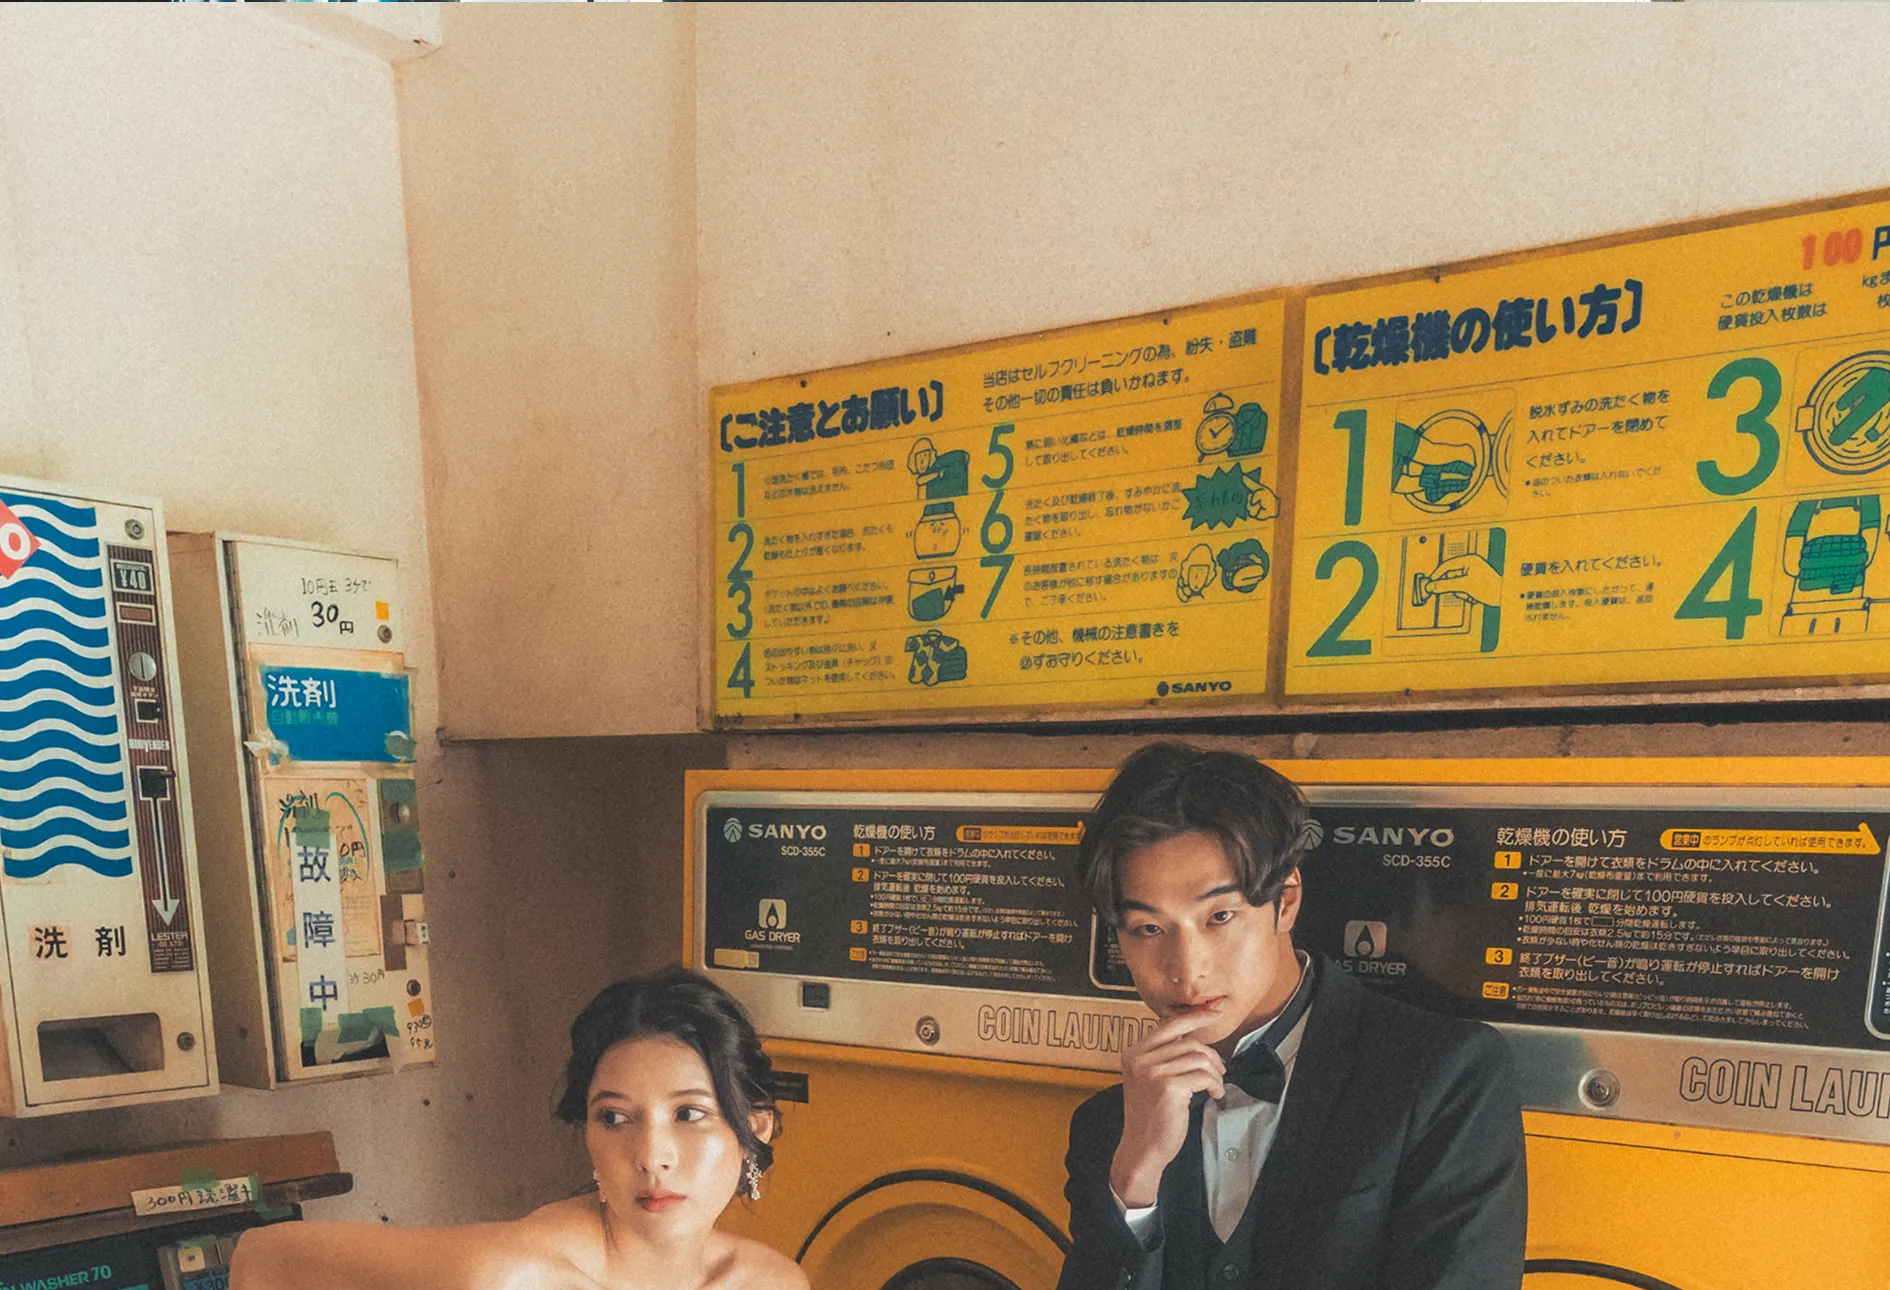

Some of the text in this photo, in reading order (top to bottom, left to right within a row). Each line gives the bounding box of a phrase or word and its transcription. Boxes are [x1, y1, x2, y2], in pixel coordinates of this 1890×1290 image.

[1696, 356, 1783, 497] 3
[980, 423, 1016, 490] 5
[1332, 408, 1368, 527] 1
[1525, 450, 1588, 470] ください。
[731, 462, 746, 519] 1
[980, 488, 1014, 554] 6
[727, 522, 755, 582] 2
[1673, 505, 1763, 641] 4
[979, 553, 1016, 620] 7
[1305, 539, 1380, 658] 2
[726, 581, 754, 639] 3
[726, 641, 756, 700] 4
[267, 673, 338, 709] 洗剤
[1171, 681, 1232, 693] SANYO
[748, 823, 828, 841] SANYO
[852, 823, 936, 841] 乾燥機の使い方
[1332, 826, 1455, 848] SANYO
[1495, 827, 1628, 848] 乾燥機の使い方
[780, 845, 826, 857] SCD-355C
[1382, 853, 1452, 869] SCD-355C
[1528, 853, 1820, 875] ドアーを開けて衣類をドラムの中に入れてください。
[1499, 884, 1832, 910] 2 ドアーを確実に閉じて100円硬貨を投入してください。
[744, 930, 801, 943] GAS DRYER
[1358, 961, 1407, 976] DRYER
[1494, 950, 1504, 964] 3
[1517, 965, 1666, 987] 衣類を取り出してください。
[978, 1004, 1041, 1046] COIN
[1679, 1056, 1783, 1110] COIN
[91, 1264, 112, 1282] 70
